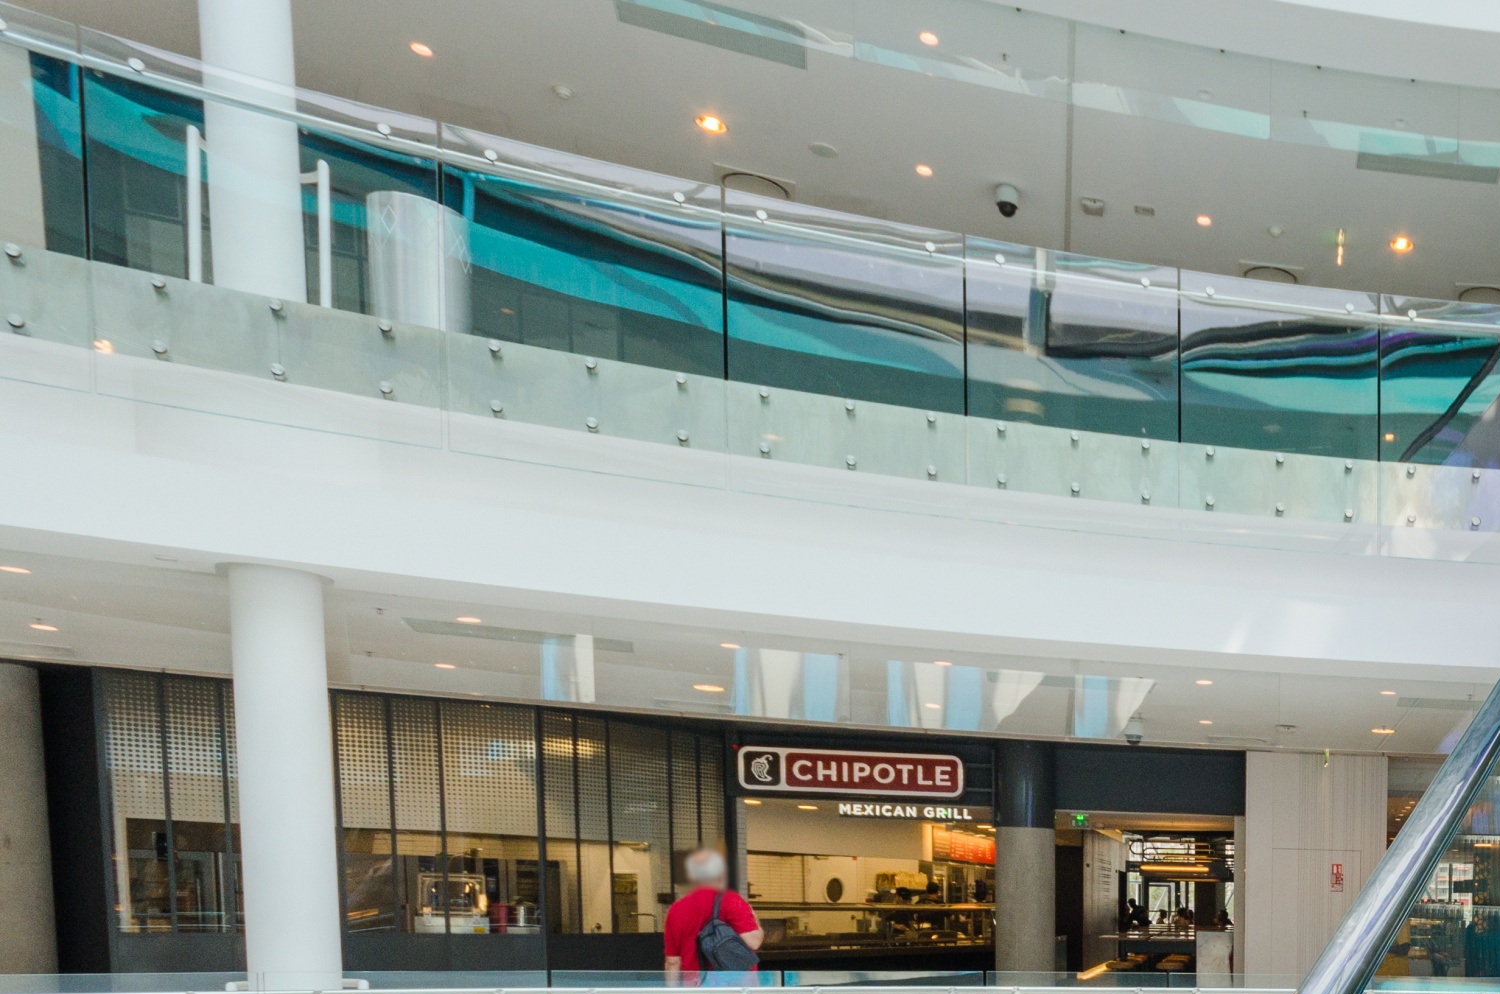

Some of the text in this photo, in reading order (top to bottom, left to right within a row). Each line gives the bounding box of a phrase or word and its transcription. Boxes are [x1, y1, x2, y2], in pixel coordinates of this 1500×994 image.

[792, 759, 952, 787] CHIPOTLE
[838, 803, 973, 820] MEXICAN GRILL
